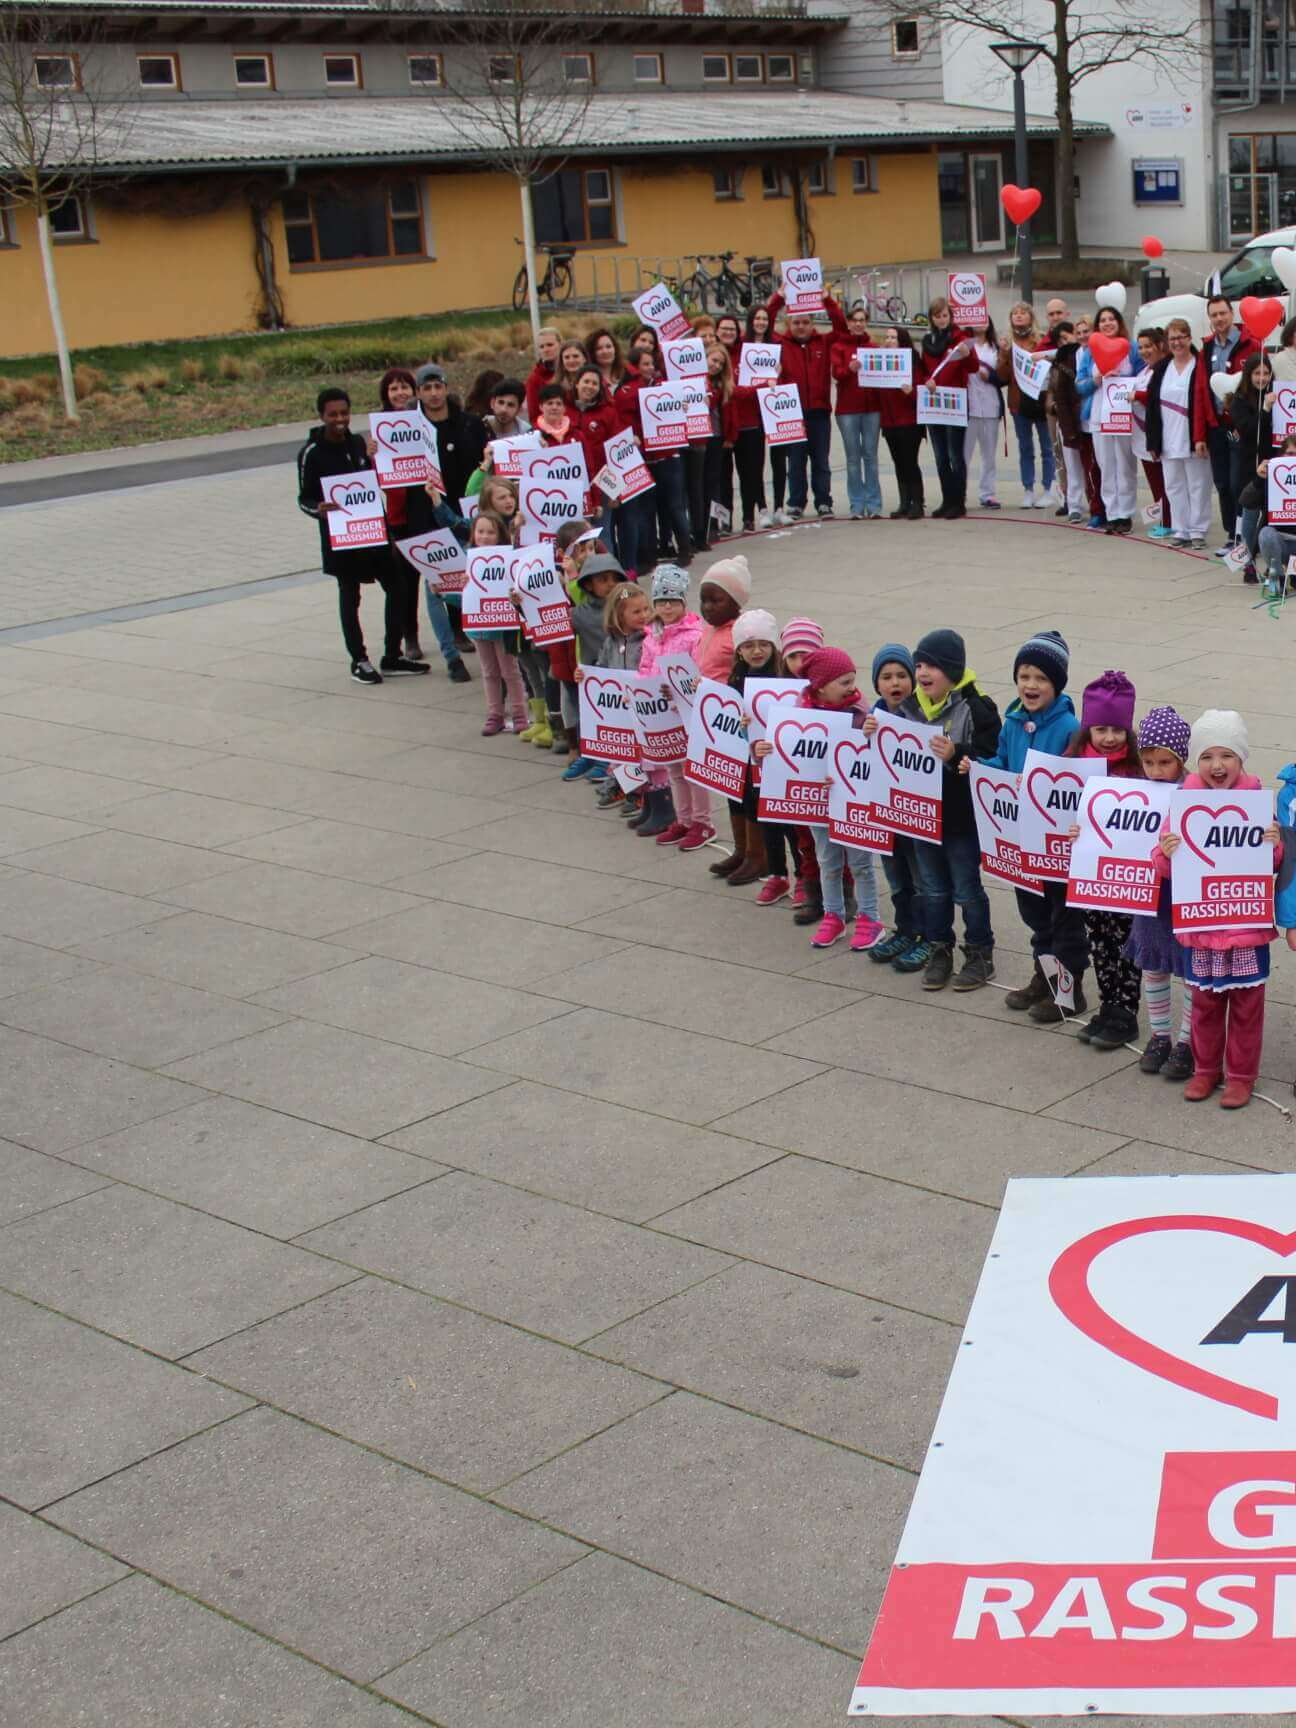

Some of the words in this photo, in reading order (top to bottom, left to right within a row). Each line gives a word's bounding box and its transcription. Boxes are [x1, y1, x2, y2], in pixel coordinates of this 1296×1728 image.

[796, 272, 818, 283] AWO
[962, 286, 982, 296] AWO
[650, 298, 671, 316] AWO
[954, 306, 986, 316] GEGEN
[678, 352, 702, 364] AWO
[753, 357, 776, 368] AWO
[656, 400, 681, 412] AWO
[774, 398, 797, 411] AWO
[390, 430, 420, 444] AWO
[616, 444, 634, 462] AWO
[548, 466, 581, 480] AWO
[345, 490, 376, 506] AWO
[540, 502, 578, 518] AWO
[351, 520, 382, 532] GEGEN
[427, 546, 458, 563] AWO
[481, 568, 505, 580] AW
[527, 570, 554, 590] AWO
[468, 613, 516, 624] RASSISMUS!
[541, 606, 568, 621] GEGEN
[535, 621, 570, 636] RASSISMUS!
[680, 678, 696, 695] AW
[636, 698, 668, 715] AWO
[600, 730, 635, 745] GEGEN
[648, 730, 686, 747] GEGEN
[585, 740, 635, 758] RASSISMUS!
[792, 738, 828, 760] AW
[708, 754, 742, 778] GEGEN
[892, 748, 936, 774] AWO
[690, 762, 741, 792] RASSISMUS!
[790, 785, 829, 802] GEGE
[1046, 790, 1082, 811] AW
[893, 795, 936, 818] GEGEN
[992, 798, 1019, 822] AW
[875, 805, 936, 833] RASSISMUS!
[1106, 808, 1162, 833] AWO
[834, 822, 889, 844] RASSISMUS!
[1204, 826, 1265, 848] AWO
[1000, 844, 1022, 865] GEG
[1028, 854, 1070, 872] RASSIS
[1102, 863, 1156, 885] GEGEN
[1075, 880, 1154, 903] RASSISMUS!
[1207, 882, 1266, 899] GEGEN
[1181, 902, 1266, 920] RASSISMUS!
